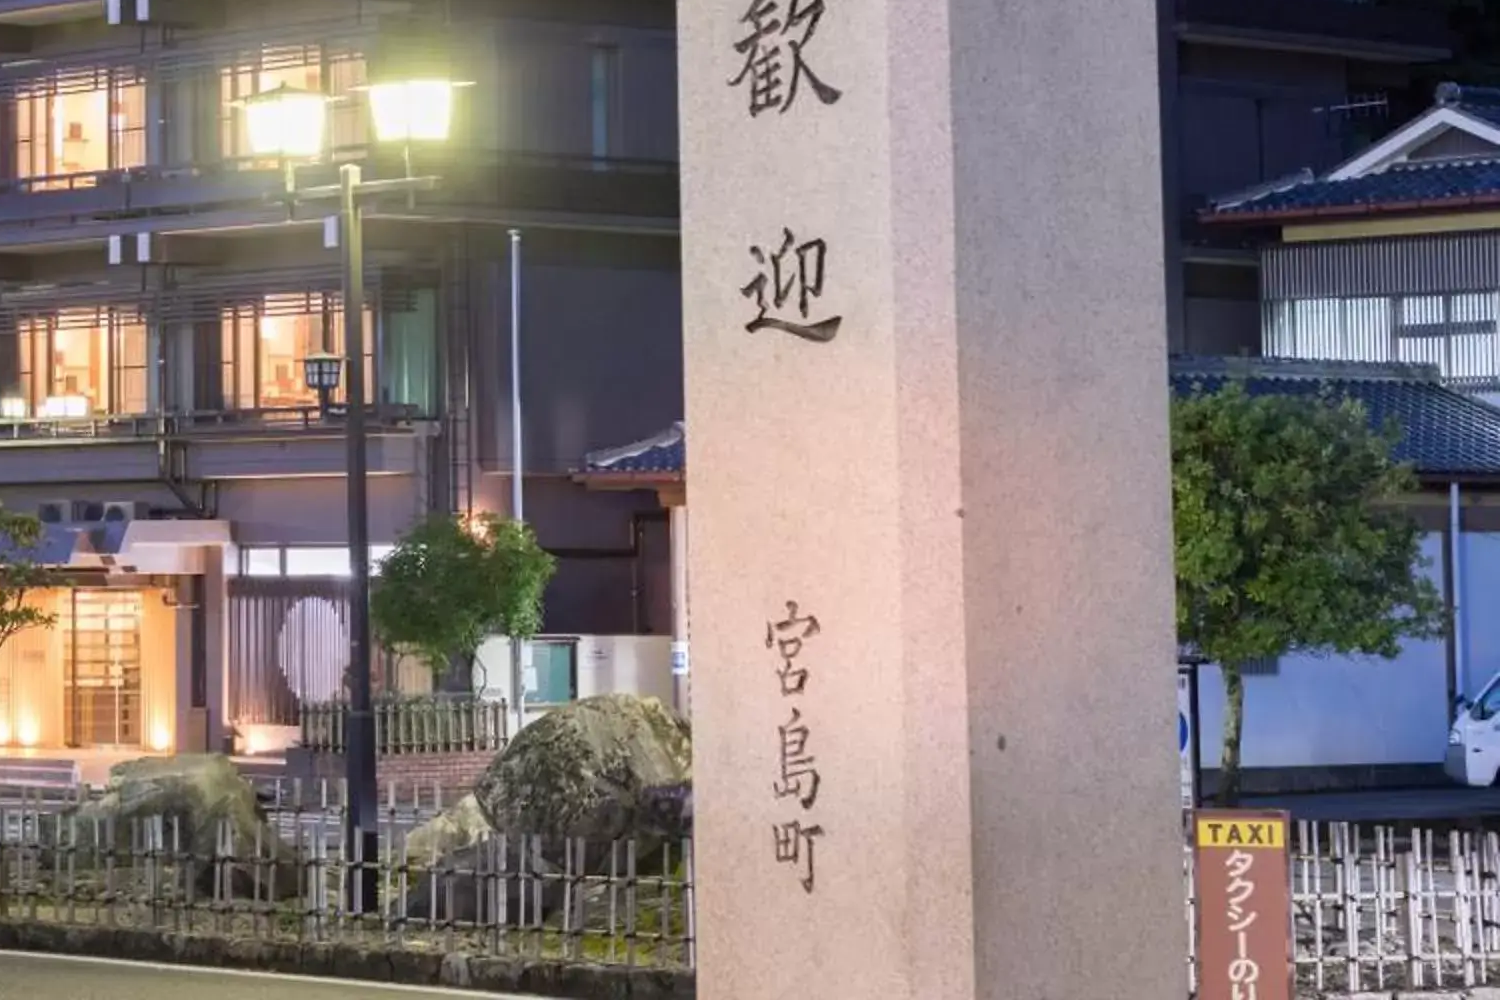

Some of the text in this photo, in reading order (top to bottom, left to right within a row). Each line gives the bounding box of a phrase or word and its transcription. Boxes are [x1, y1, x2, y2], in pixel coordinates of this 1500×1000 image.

[765, 600, 825, 895] 宮島町
[1207, 823, 1274, 844] TAXI
